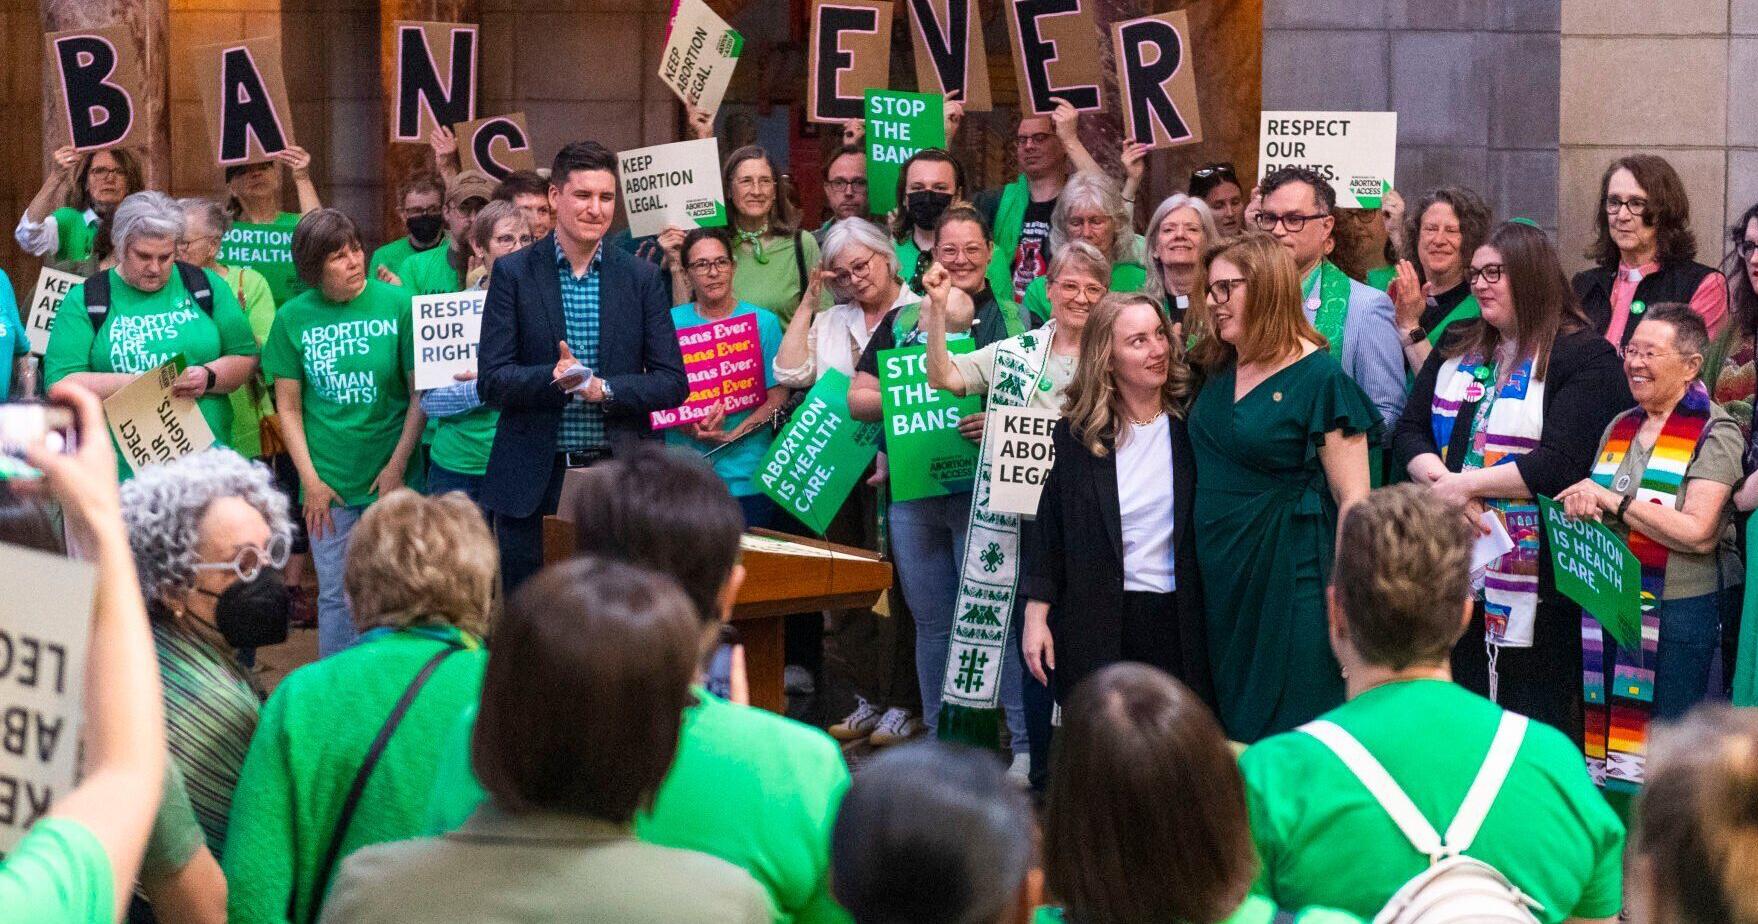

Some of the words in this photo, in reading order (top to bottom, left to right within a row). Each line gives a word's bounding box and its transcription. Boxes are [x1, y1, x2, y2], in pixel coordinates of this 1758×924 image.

[677, 26, 708, 95] ABORTION
[815, 4, 879, 122] E
[908, 0, 971, 103] V
[1013, 0, 1101, 115] E
[664, 46, 681, 82] KEEP
[55, 34, 134, 151] B
[396, 25, 476, 141] N
[1119, 18, 1193, 147] R
[218, 45, 288, 164] A
[870, 95, 926, 117] STOP
[870, 119, 911, 141] THE
[1267, 119, 1351, 137] RESPECT
[872, 143, 923, 164] BAN
[1266, 141, 1306, 158] OUR
[622, 155, 653, 174] KEEP
[626, 169, 693, 194] ABORTION
[628, 194, 668, 213] LEGAL.
[45, 276, 70, 295] KE
[110, 309, 199, 329] ABORTION
[420, 299, 483, 319] RESPE
[34, 314, 55, 332] LE
[109, 325, 179, 343] RIGHTS
[301, 319, 398, 345] ABORTION
[421, 322, 464, 341] OUR
[713, 322, 752, 339] Ever.
[110, 340, 149, 359] ARE
[304, 337, 370, 361] RIGHTS
[422, 343, 480, 363] RIGHT
[716, 340, 754, 357] Ever.
[111, 352, 177, 374] HUMA
[720, 358, 757, 377] Ever.
[722, 377, 758, 395] Ever.
[887, 382, 940, 407] THE
[651, 410, 676, 425] No
[678, 405, 712, 421] Ban
[724, 393, 760, 411] Ever.
[892, 406, 961, 436] BANS
[760, 397, 827, 489] ABORTION
[777, 480, 796, 501] IS
[789, 412, 842, 481] HEALTH
[795, 464, 836, 513] CARE.
[1548, 506, 1623, 571] ABORTION
[1552, 527, 1570, 549] IS
[1573, 537, 1623, 593] HEALTH
[1557, 551, 1600, 594] CARE.
